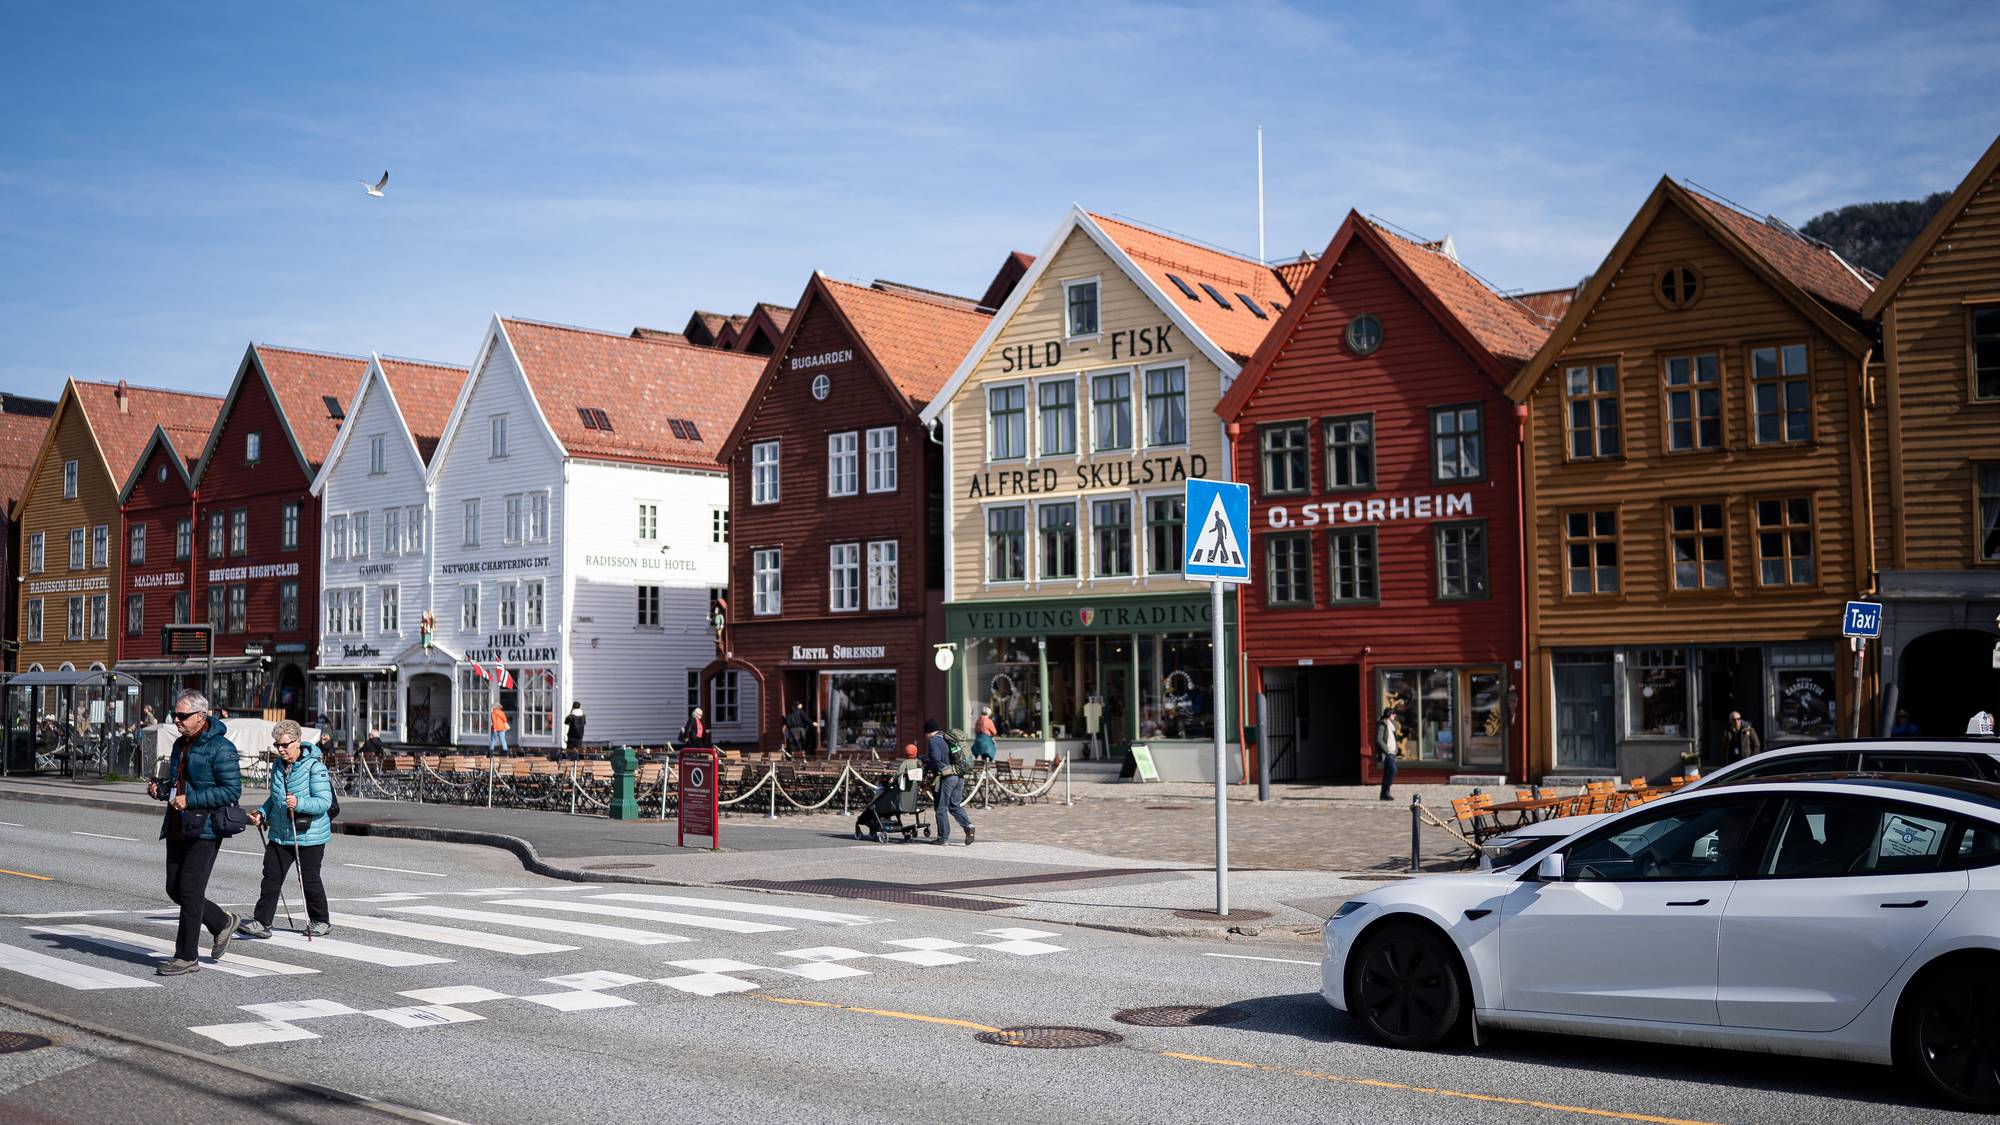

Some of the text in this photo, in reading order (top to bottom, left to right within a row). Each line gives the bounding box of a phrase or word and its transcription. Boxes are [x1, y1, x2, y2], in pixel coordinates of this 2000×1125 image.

[1002, 340, 1062, 373] SILD
[1111, 323, 1175, 360] FISK
[791, 349, 853, 370] BUGAARDEN
[969, 454, 1208, 498] ALFRED SKULSTAD
[1301, 492, 1473, 526] STORHEIM
[208, 562, 299, 582] BRYGGEN NIGHTCLUB
[442, 557, 551, 574] NETWORK CHARTERING INT.
[585, 555, 697, 571] RADISSON BLU HOTEL
[30, 576, 109, 594] RADISSON BLU HOTEL
[134, 573, 163, 588] MADAM
[967, 604, 1213, 630] VEIDUNG TRADING
[1851, 608, 1876, 629] Taxi
[508, 647, 558, 662] GALLERY
